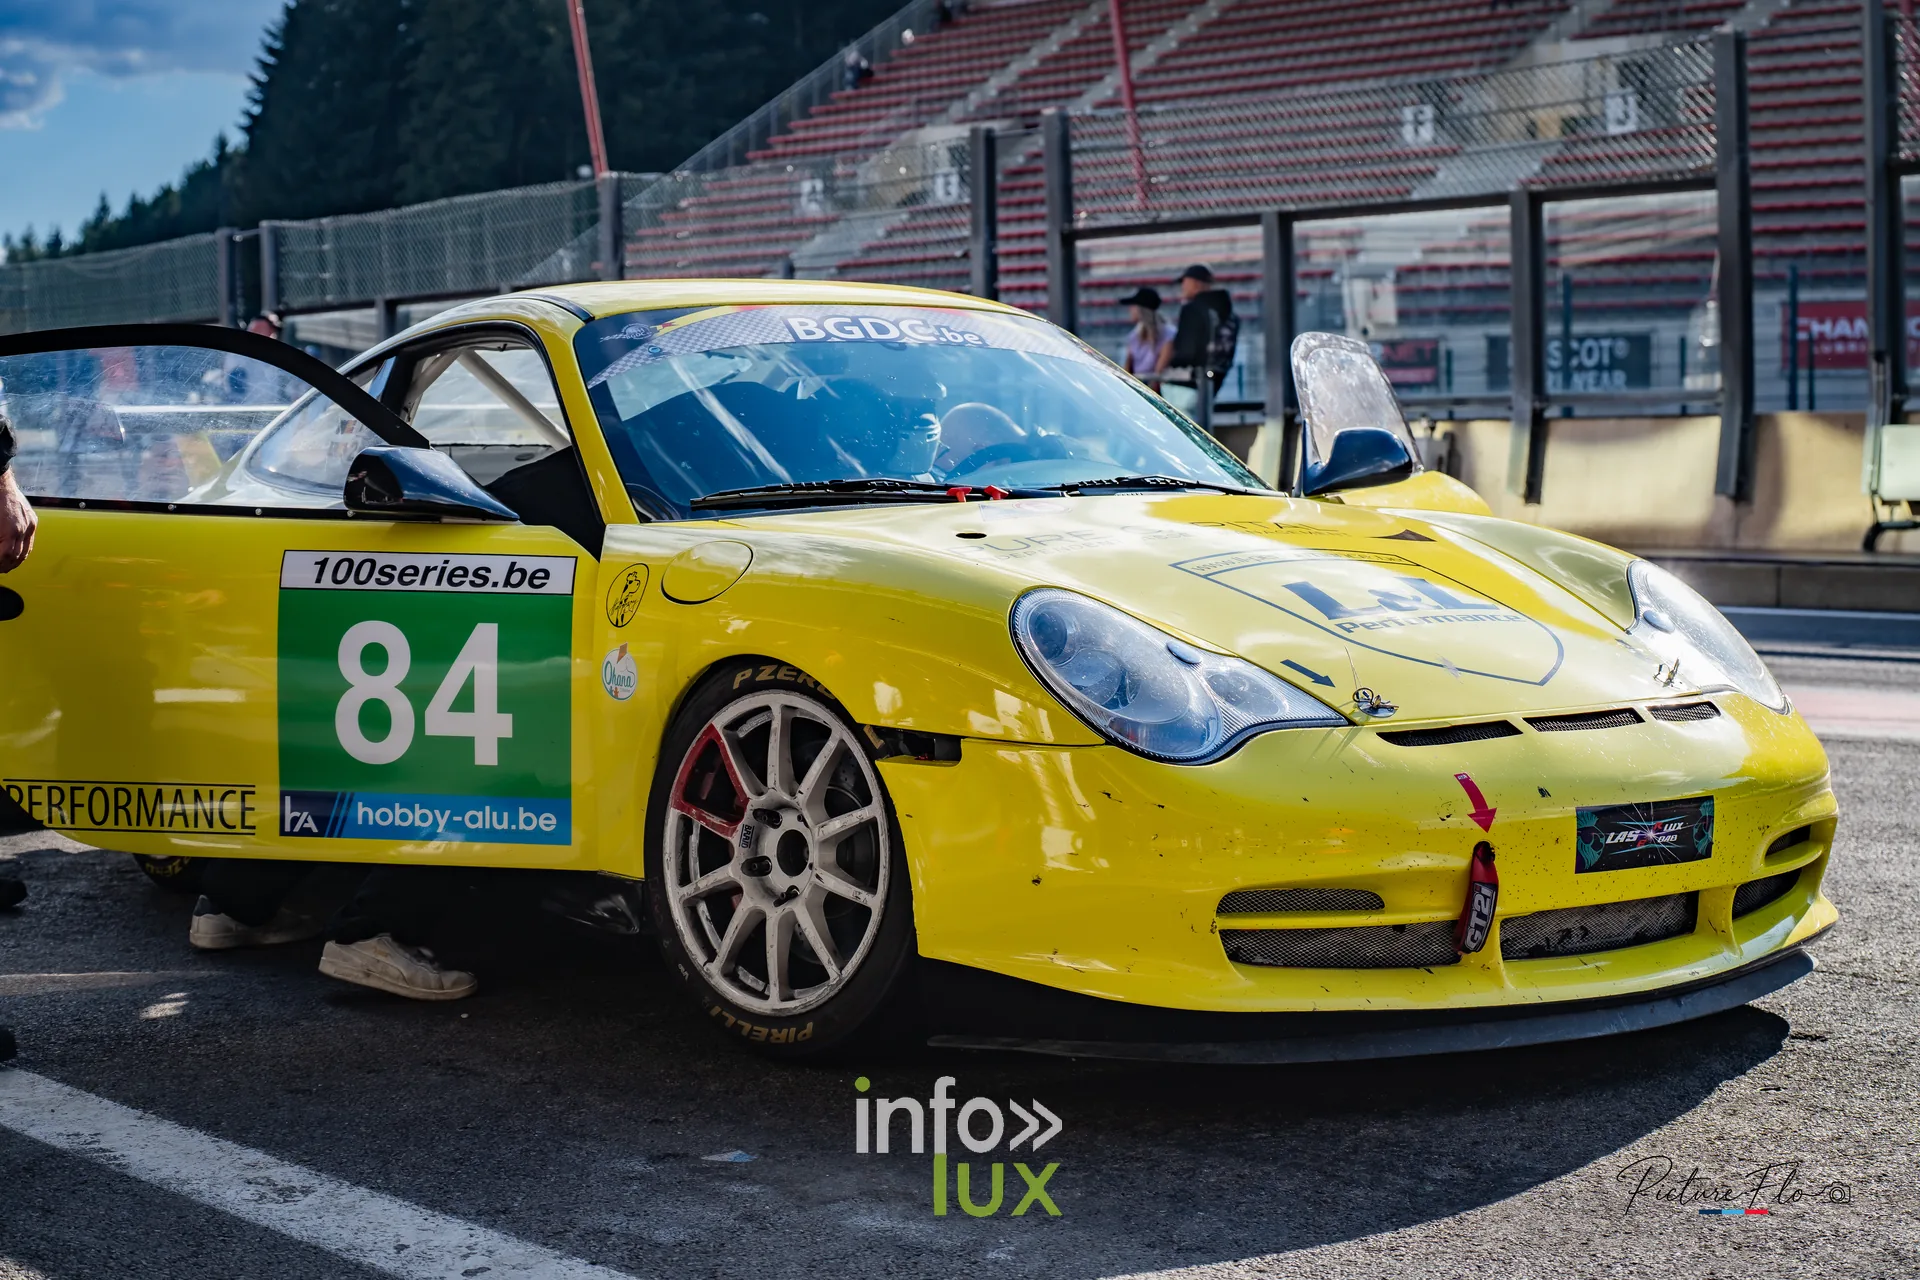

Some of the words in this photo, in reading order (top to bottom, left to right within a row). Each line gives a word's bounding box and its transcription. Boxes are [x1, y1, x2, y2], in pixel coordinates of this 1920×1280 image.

[786, 317, 983, 344] BGDC.be
[313, 557, 551, 589] 100series.be
[1282, 576, 1500, 620] L&L
[1335, 612, 1527, 634] Performance
[604, 660, 633, 688] Ohana
[732, 668, 753, 690] P
[335, 620, 513, 766] 84
[357, 801, 557, 832] hobby-alu.be
[741, 823, 753, 849] BRAID
[709, 1005, 814, 1043] PIRELLI
